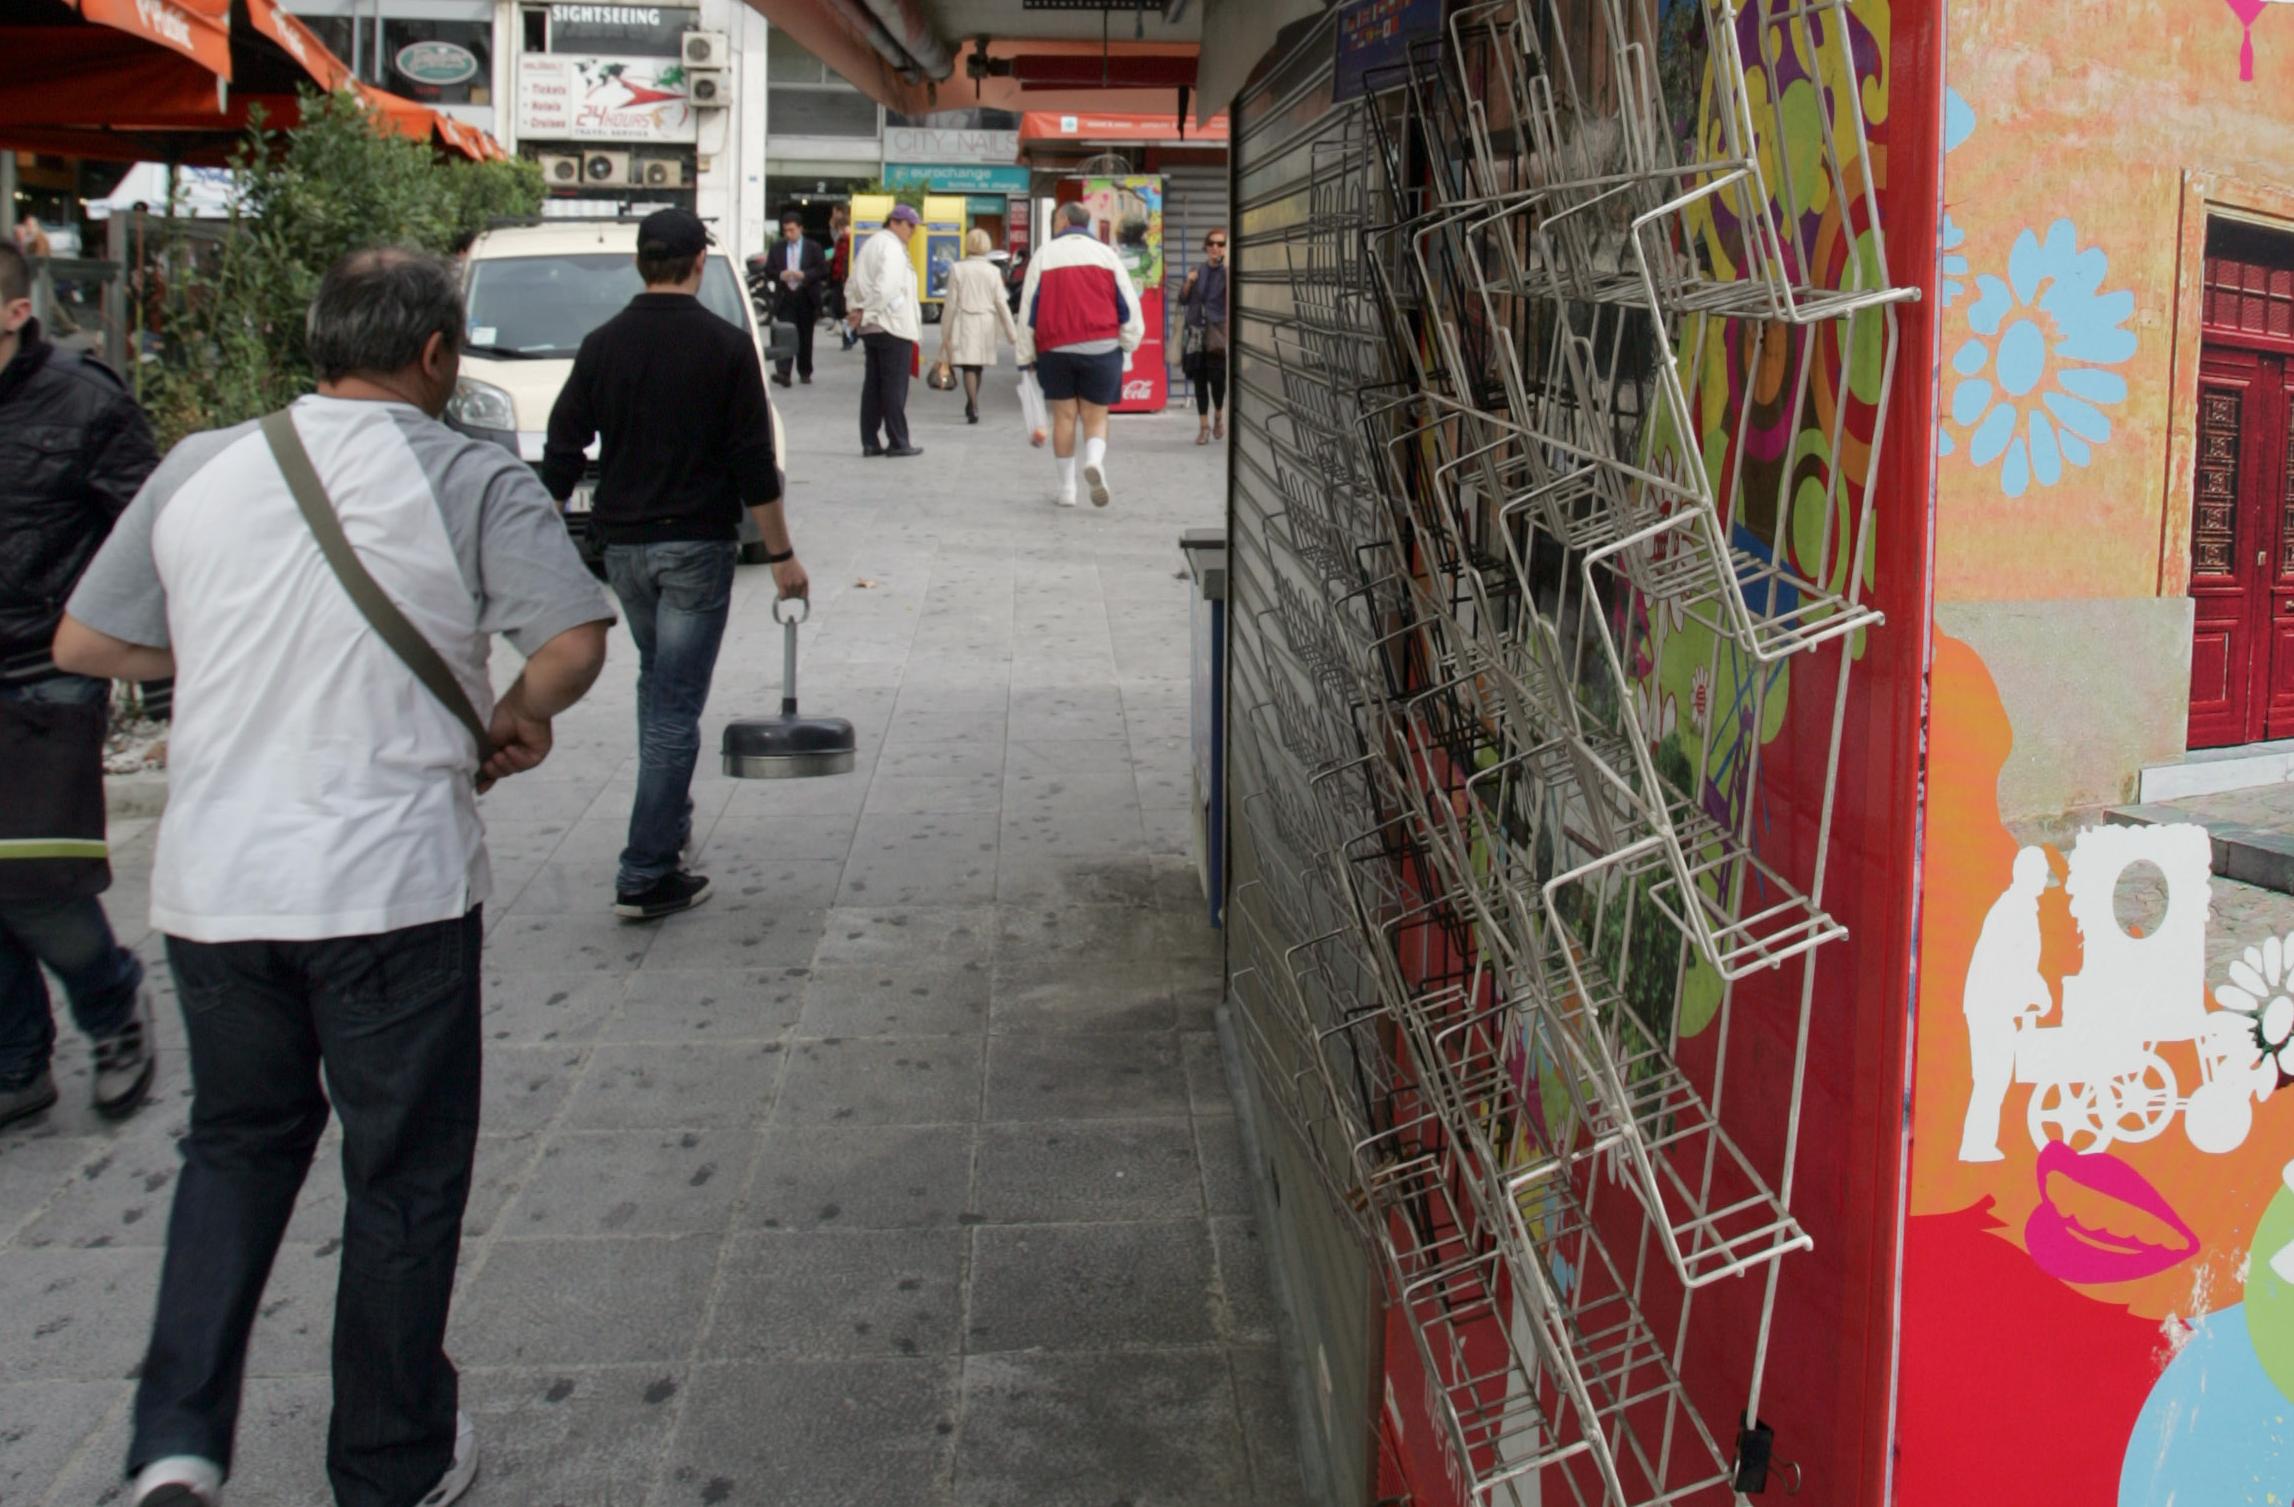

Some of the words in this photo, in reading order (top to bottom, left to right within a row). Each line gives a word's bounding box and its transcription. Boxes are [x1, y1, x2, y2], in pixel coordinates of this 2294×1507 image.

[552, 4, 660, 25] SIGHTSEEING
[532, 84, 566, 95] Tickets
[531, 119, 566, 128] Cruises
[895, 131, 946, 150] CITY
[959, 132, 1018, 152] NAILS
[911, 166, 992, 181] eurochange
